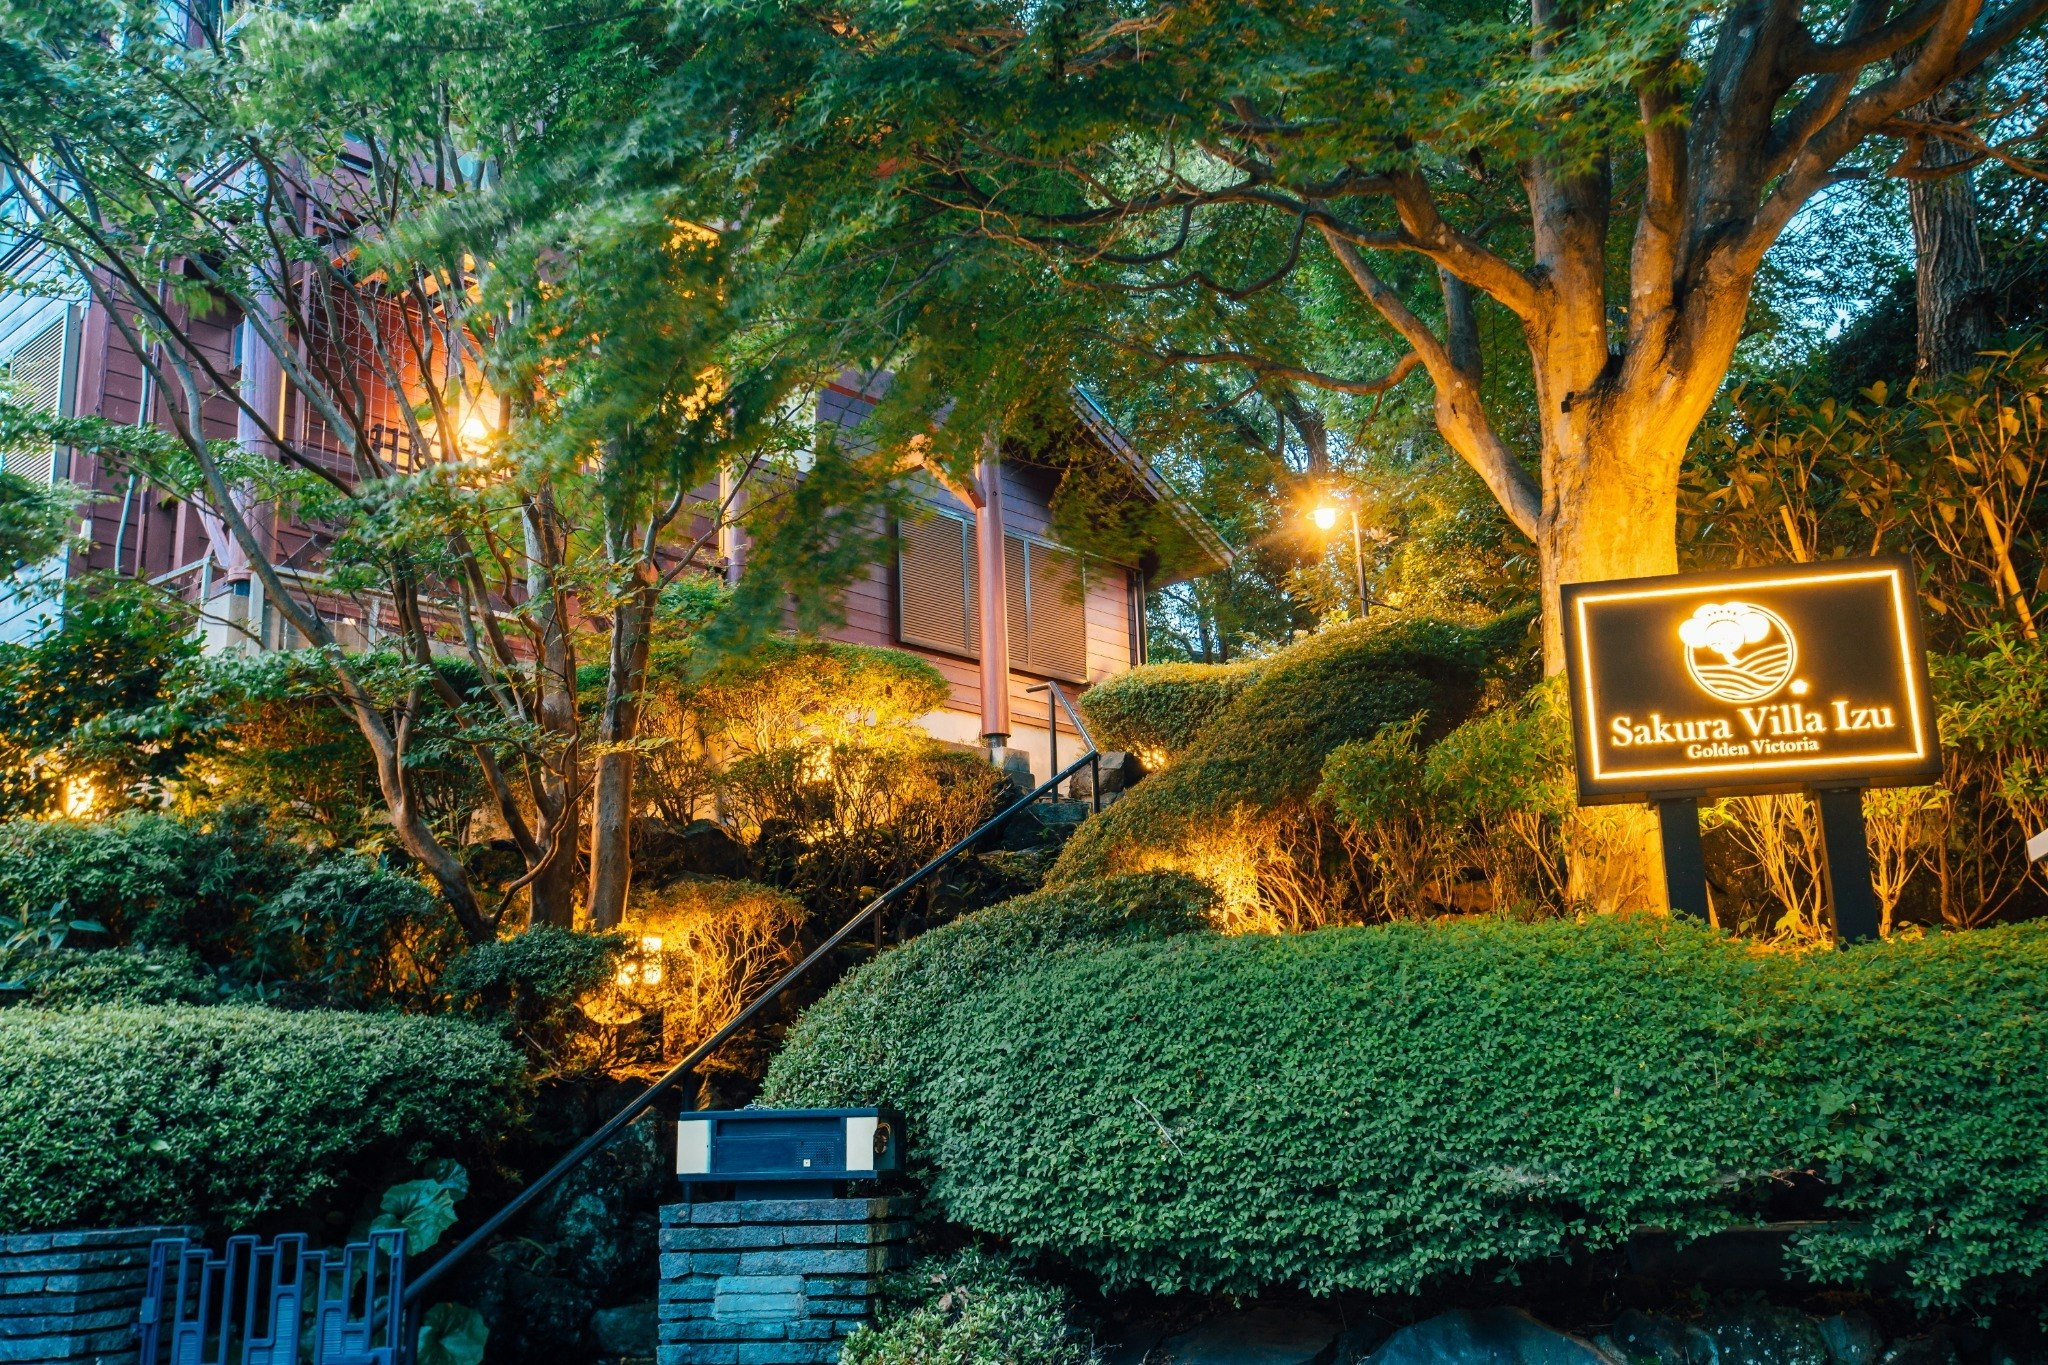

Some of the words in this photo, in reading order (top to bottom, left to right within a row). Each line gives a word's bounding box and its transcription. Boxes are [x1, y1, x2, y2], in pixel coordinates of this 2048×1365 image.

[1611, 713, 1733, 747] Sakura
[1736, 703, 1826, 738] Villa
[1831, 700, 1896, 732] Izu
[1687, 741, 1750, 759] Golden
[1753, 737, 1820, 755] Victoria
